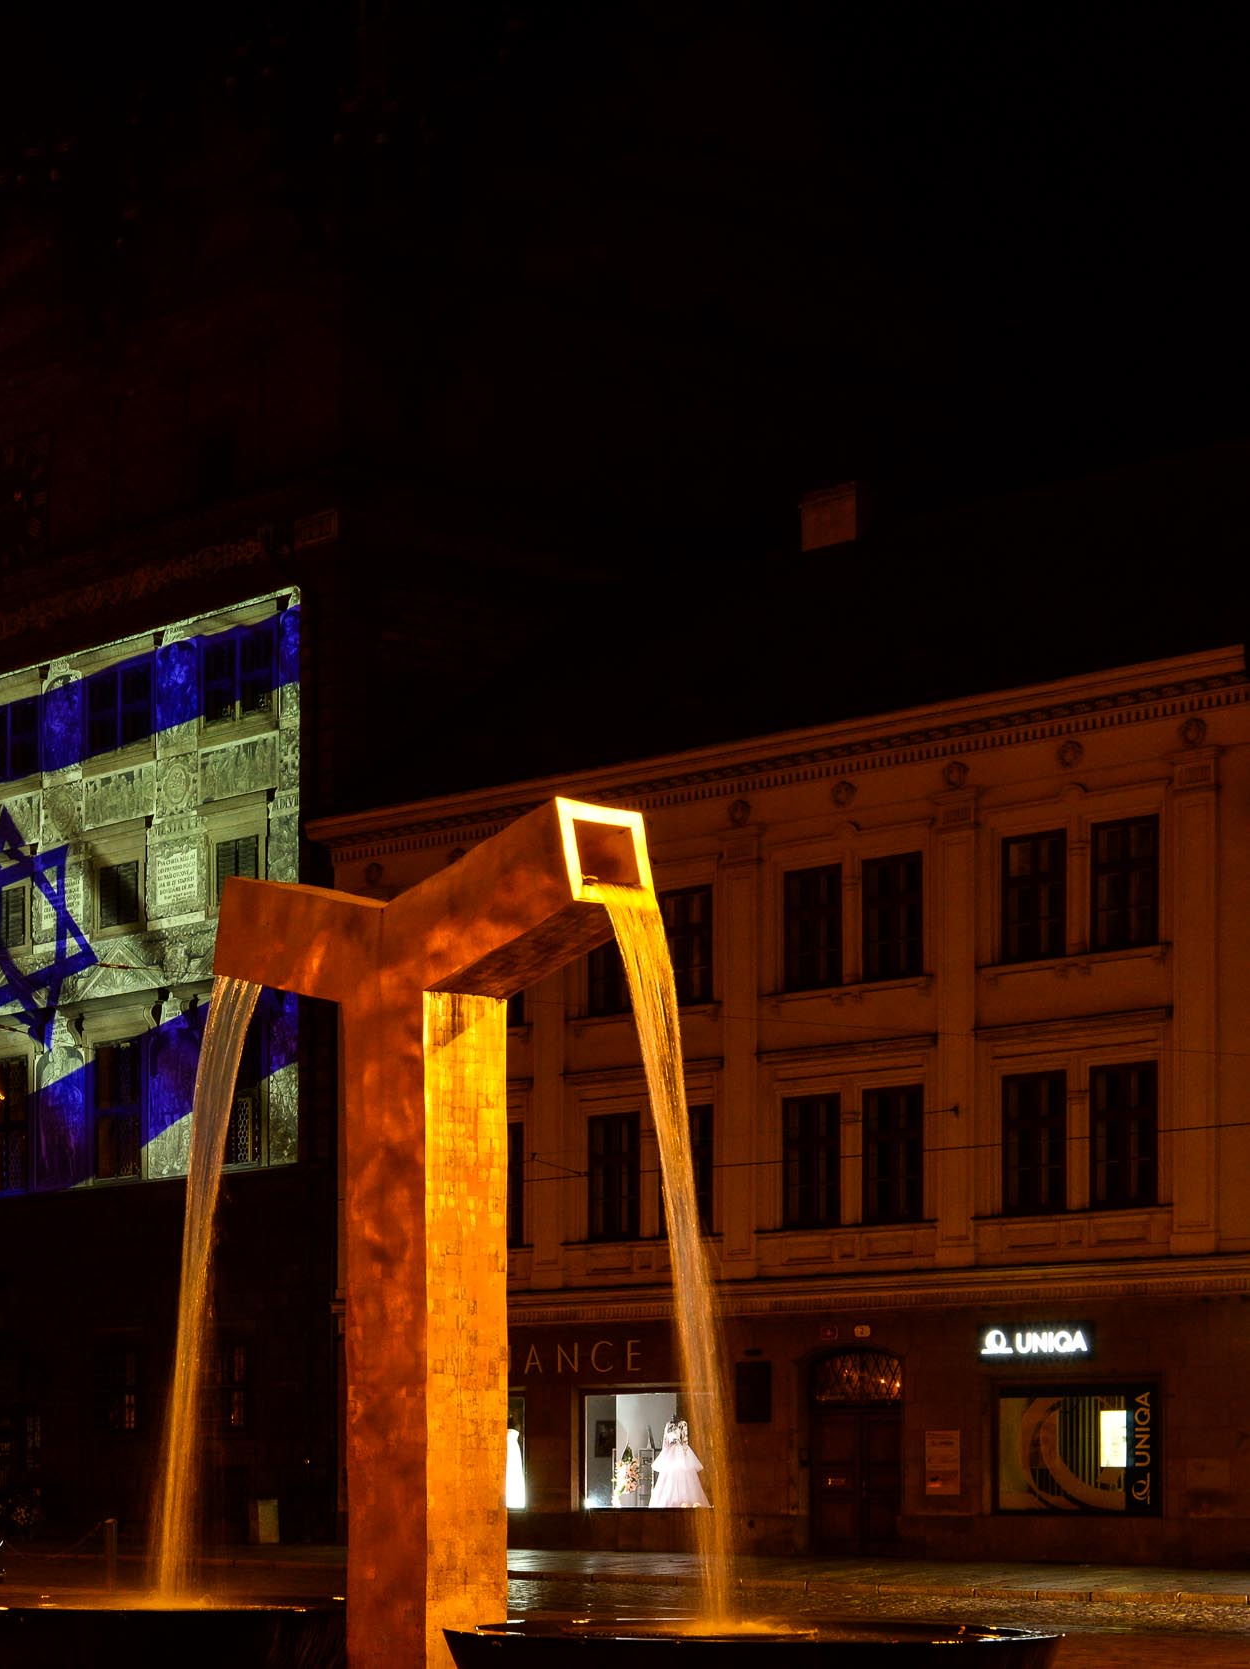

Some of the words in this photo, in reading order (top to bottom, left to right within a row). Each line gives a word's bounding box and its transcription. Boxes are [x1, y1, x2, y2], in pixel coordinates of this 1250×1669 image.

[508, 1340, 642, 1374] ANCE
[1015, 1330, 1088, 1353] UNIQA
[1134, 1391, 1150, 1468] UNIQA
